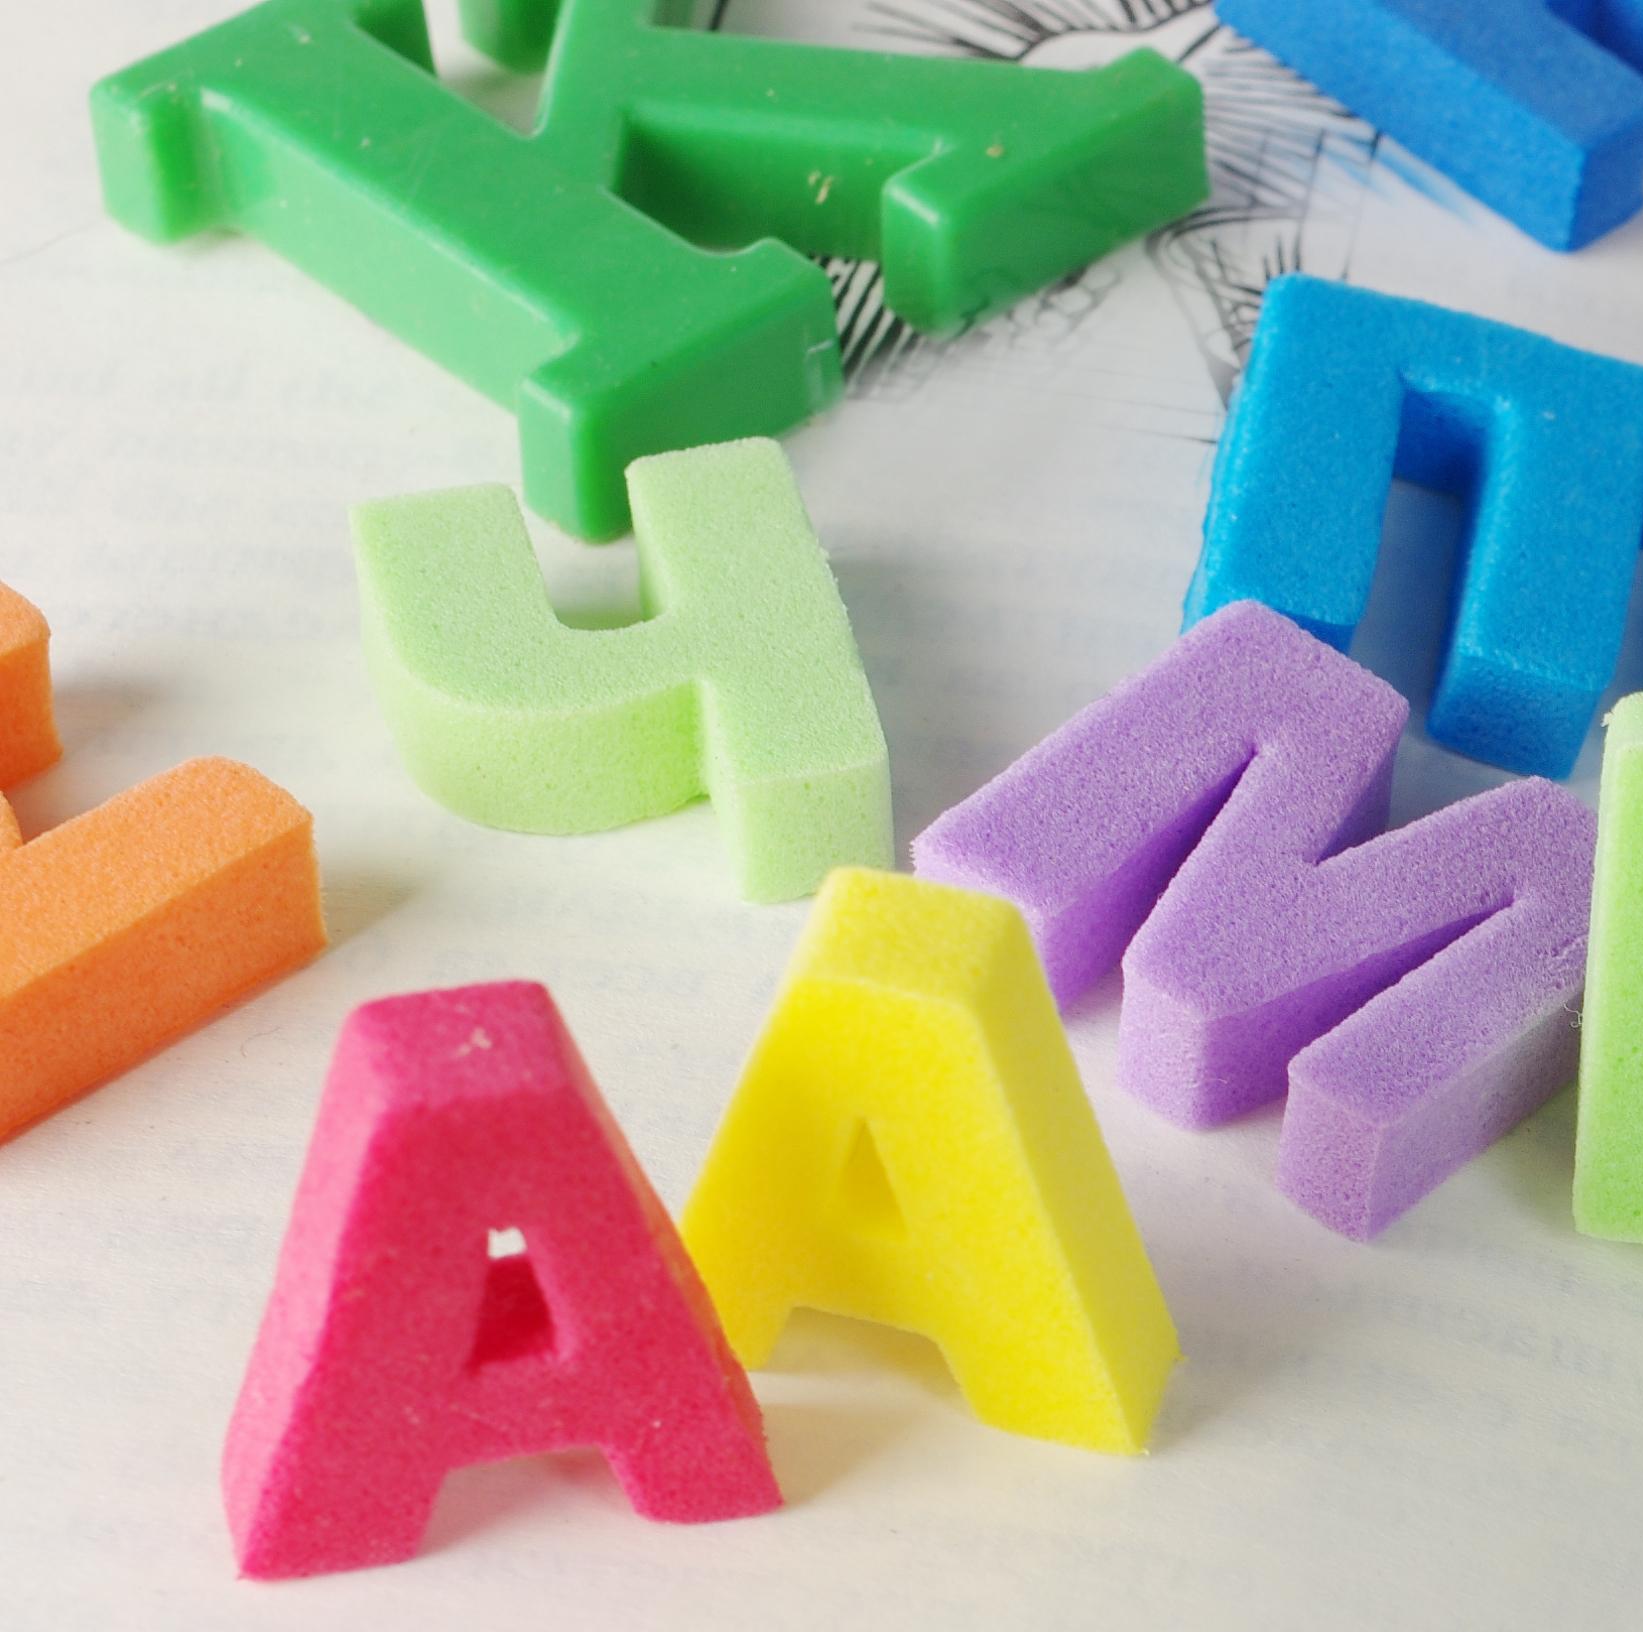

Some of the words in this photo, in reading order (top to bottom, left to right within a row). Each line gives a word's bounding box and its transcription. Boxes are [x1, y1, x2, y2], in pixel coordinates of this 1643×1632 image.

[352, 437, 895, 905] Ч
[911, 600, 1597, 1243] М
[223, 980, 786, 1582] А
[683, 867, 1182, 1457] А
